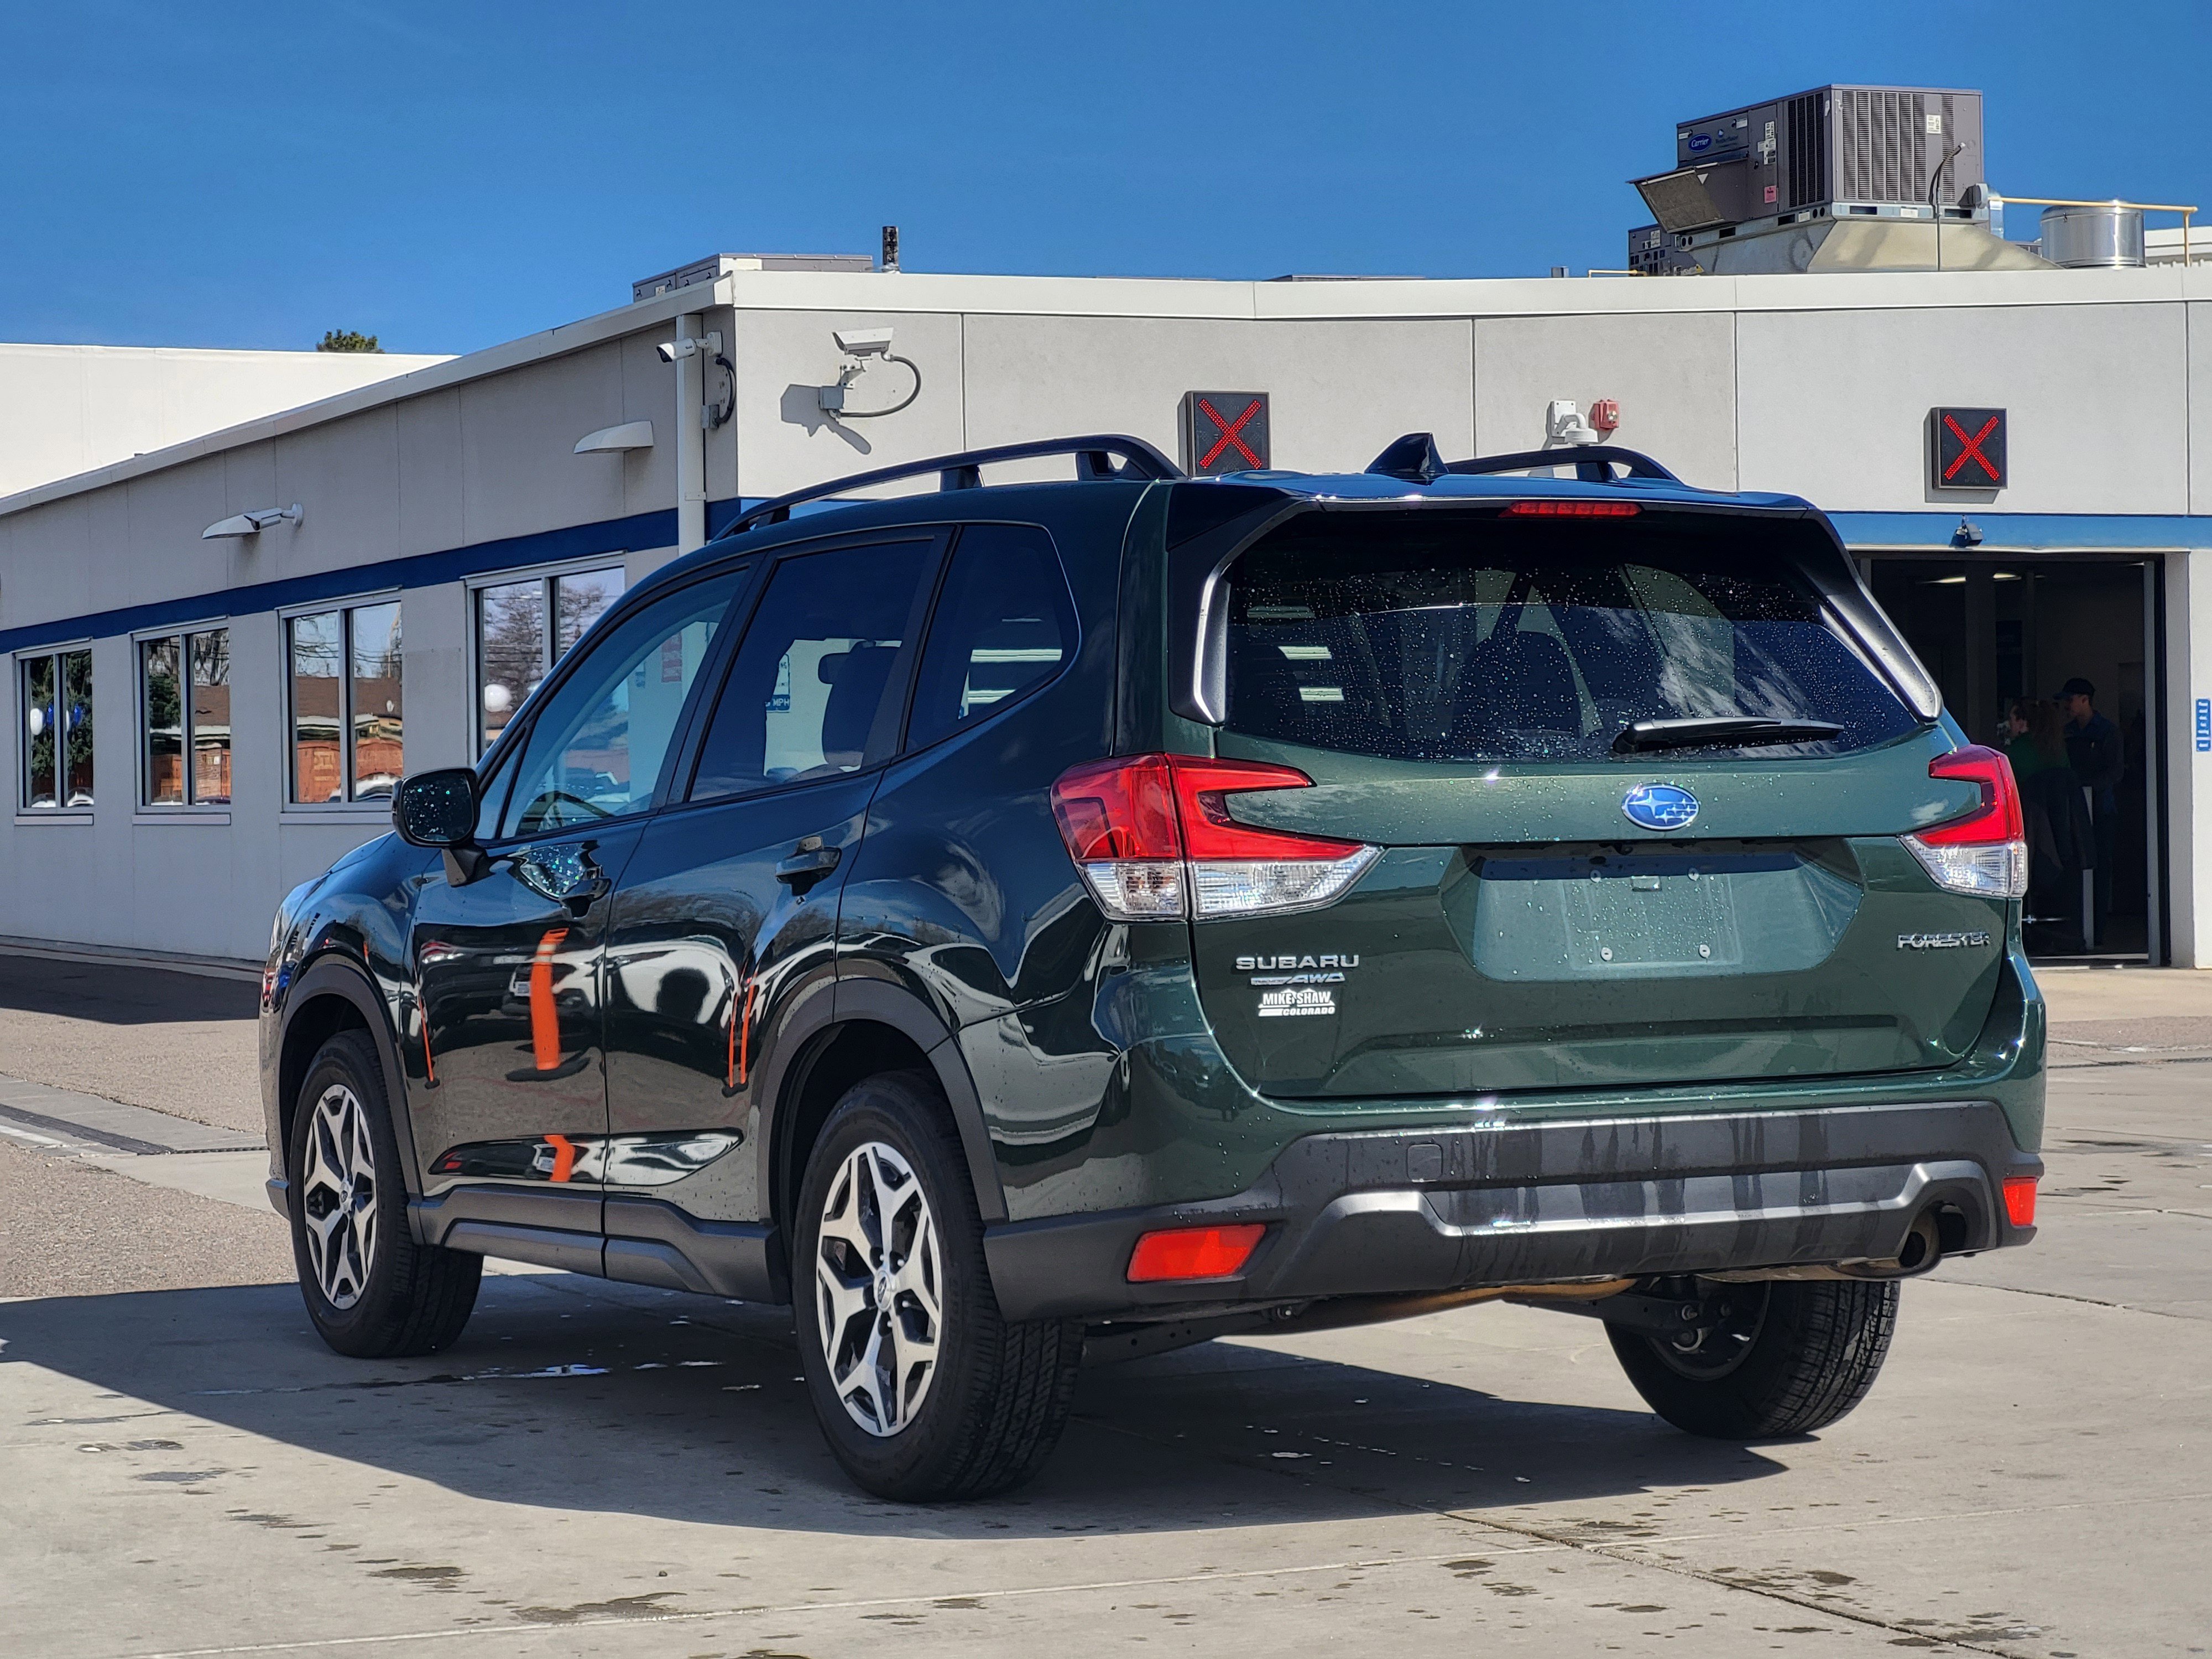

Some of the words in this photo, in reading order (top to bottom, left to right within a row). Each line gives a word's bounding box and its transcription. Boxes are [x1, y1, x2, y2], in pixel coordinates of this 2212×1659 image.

[1691, 138, 1709, 148] Carrier
[773, 698, 790, 707] MPH
[1897, 932, 1990, 948] FORESTER
[1235, 954, 1359, 970] SUBARU
[1286, 972, 1346, 984] AWD
[1263, 993, 1292, 1005] MIKE
[1297, 992, 1331, 1004] SHAW
[1282, 1006, 1335, 1016] COLORADO
